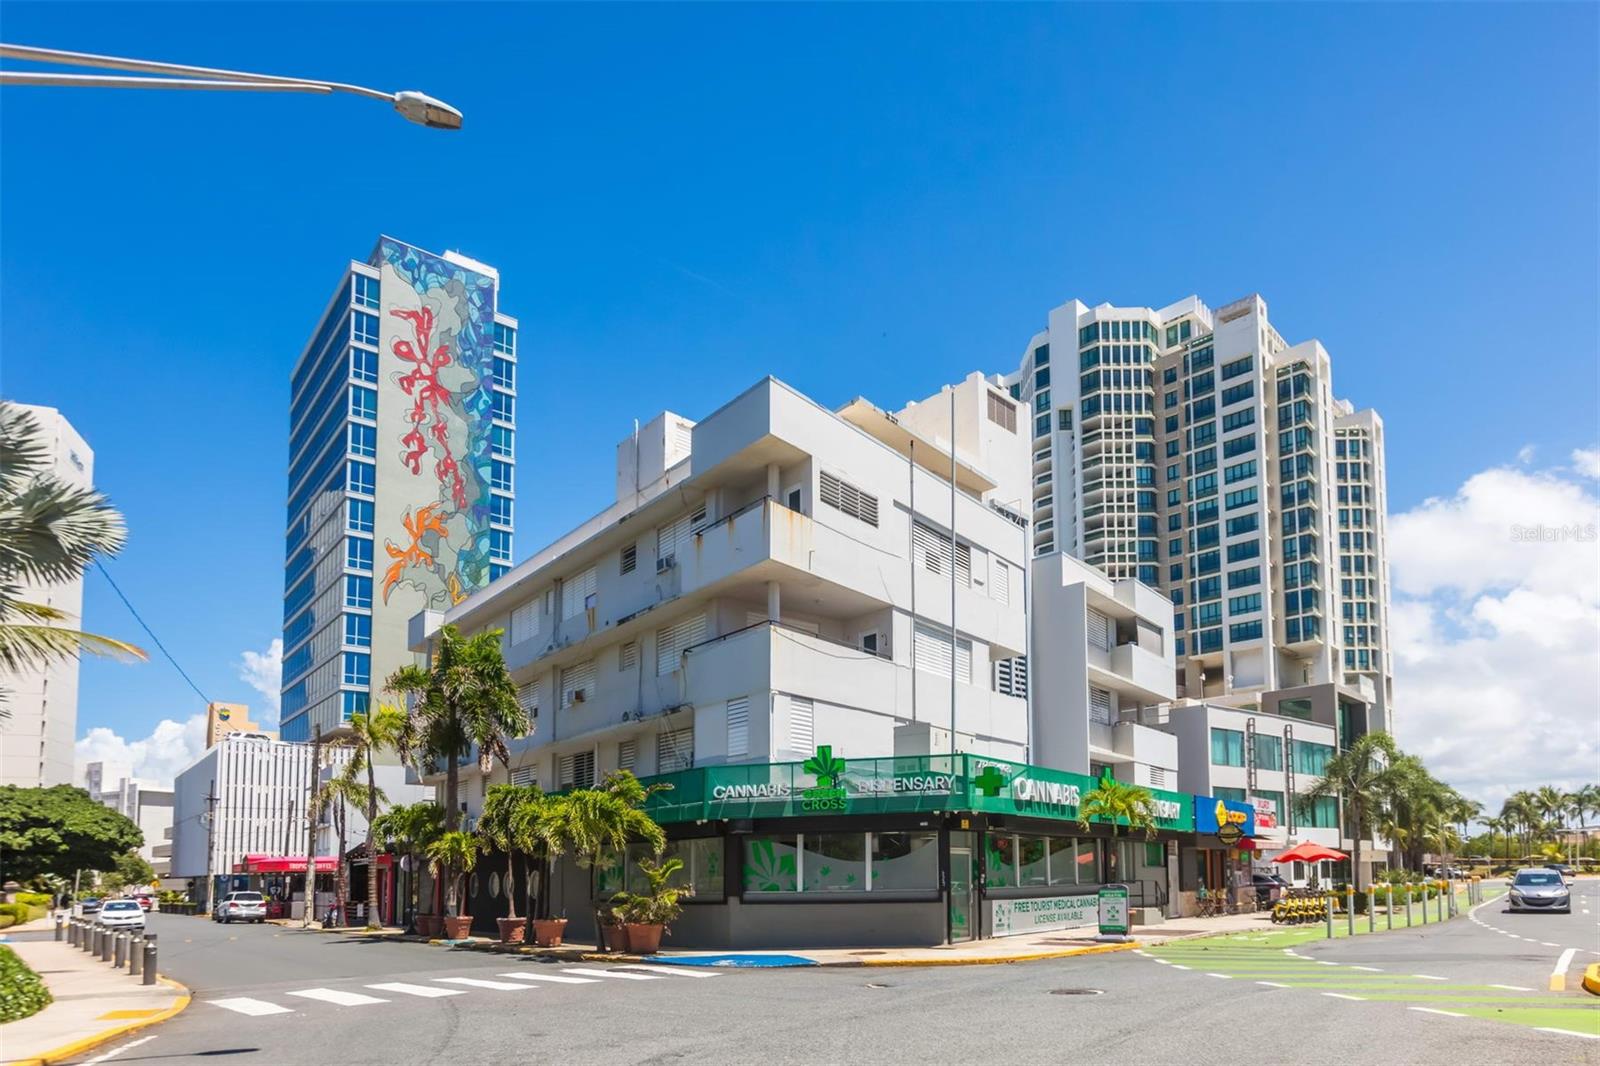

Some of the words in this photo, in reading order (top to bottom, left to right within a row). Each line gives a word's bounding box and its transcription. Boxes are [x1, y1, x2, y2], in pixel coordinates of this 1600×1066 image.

[713, 783, 791, 799] CANNABIS
[858, 775, 955, 792] DISPENSARY
[1014, 777, 1080, 807] CANNABIS
[802, 799, 847, 810] CROSS
[1014, 901, 1030, 912] FREE
[1031, 900, 1053, 911] TOURIST
[1054, 899, 1076, 910] MEDICAL
[1076, 897, 1097, 908] CANNAB
[1034, 913, 1056, 924] LICENSE
[1057, 911, 1083, 921] AVAILABLE
